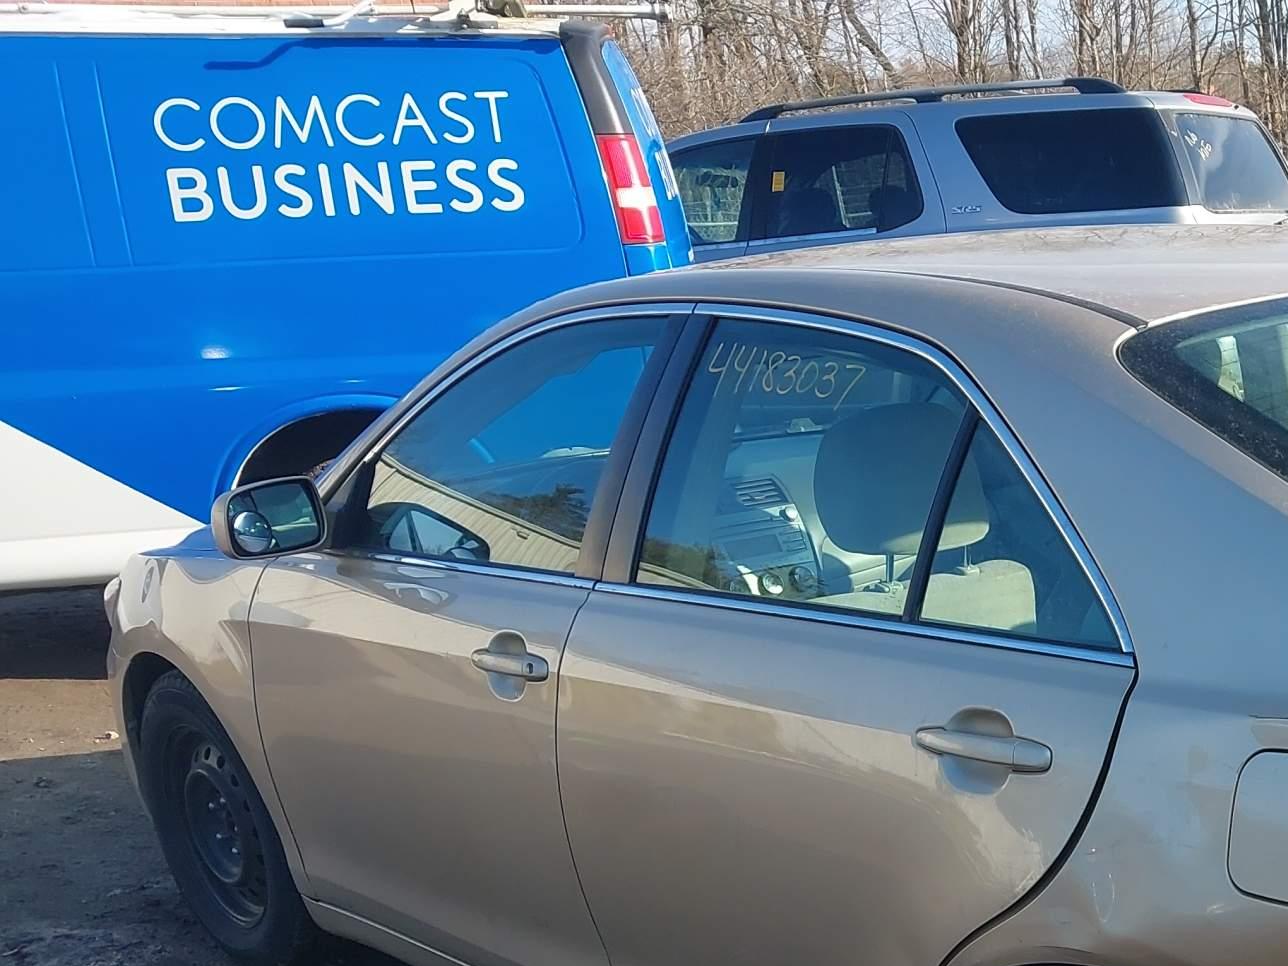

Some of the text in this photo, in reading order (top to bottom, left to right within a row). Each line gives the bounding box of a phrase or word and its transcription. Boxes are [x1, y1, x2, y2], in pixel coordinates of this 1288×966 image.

[153, 91, 509, 152] COMCAST
[166, 158, 525, 223] BUSINESS
[708, 342, 867, 411] 44183037
